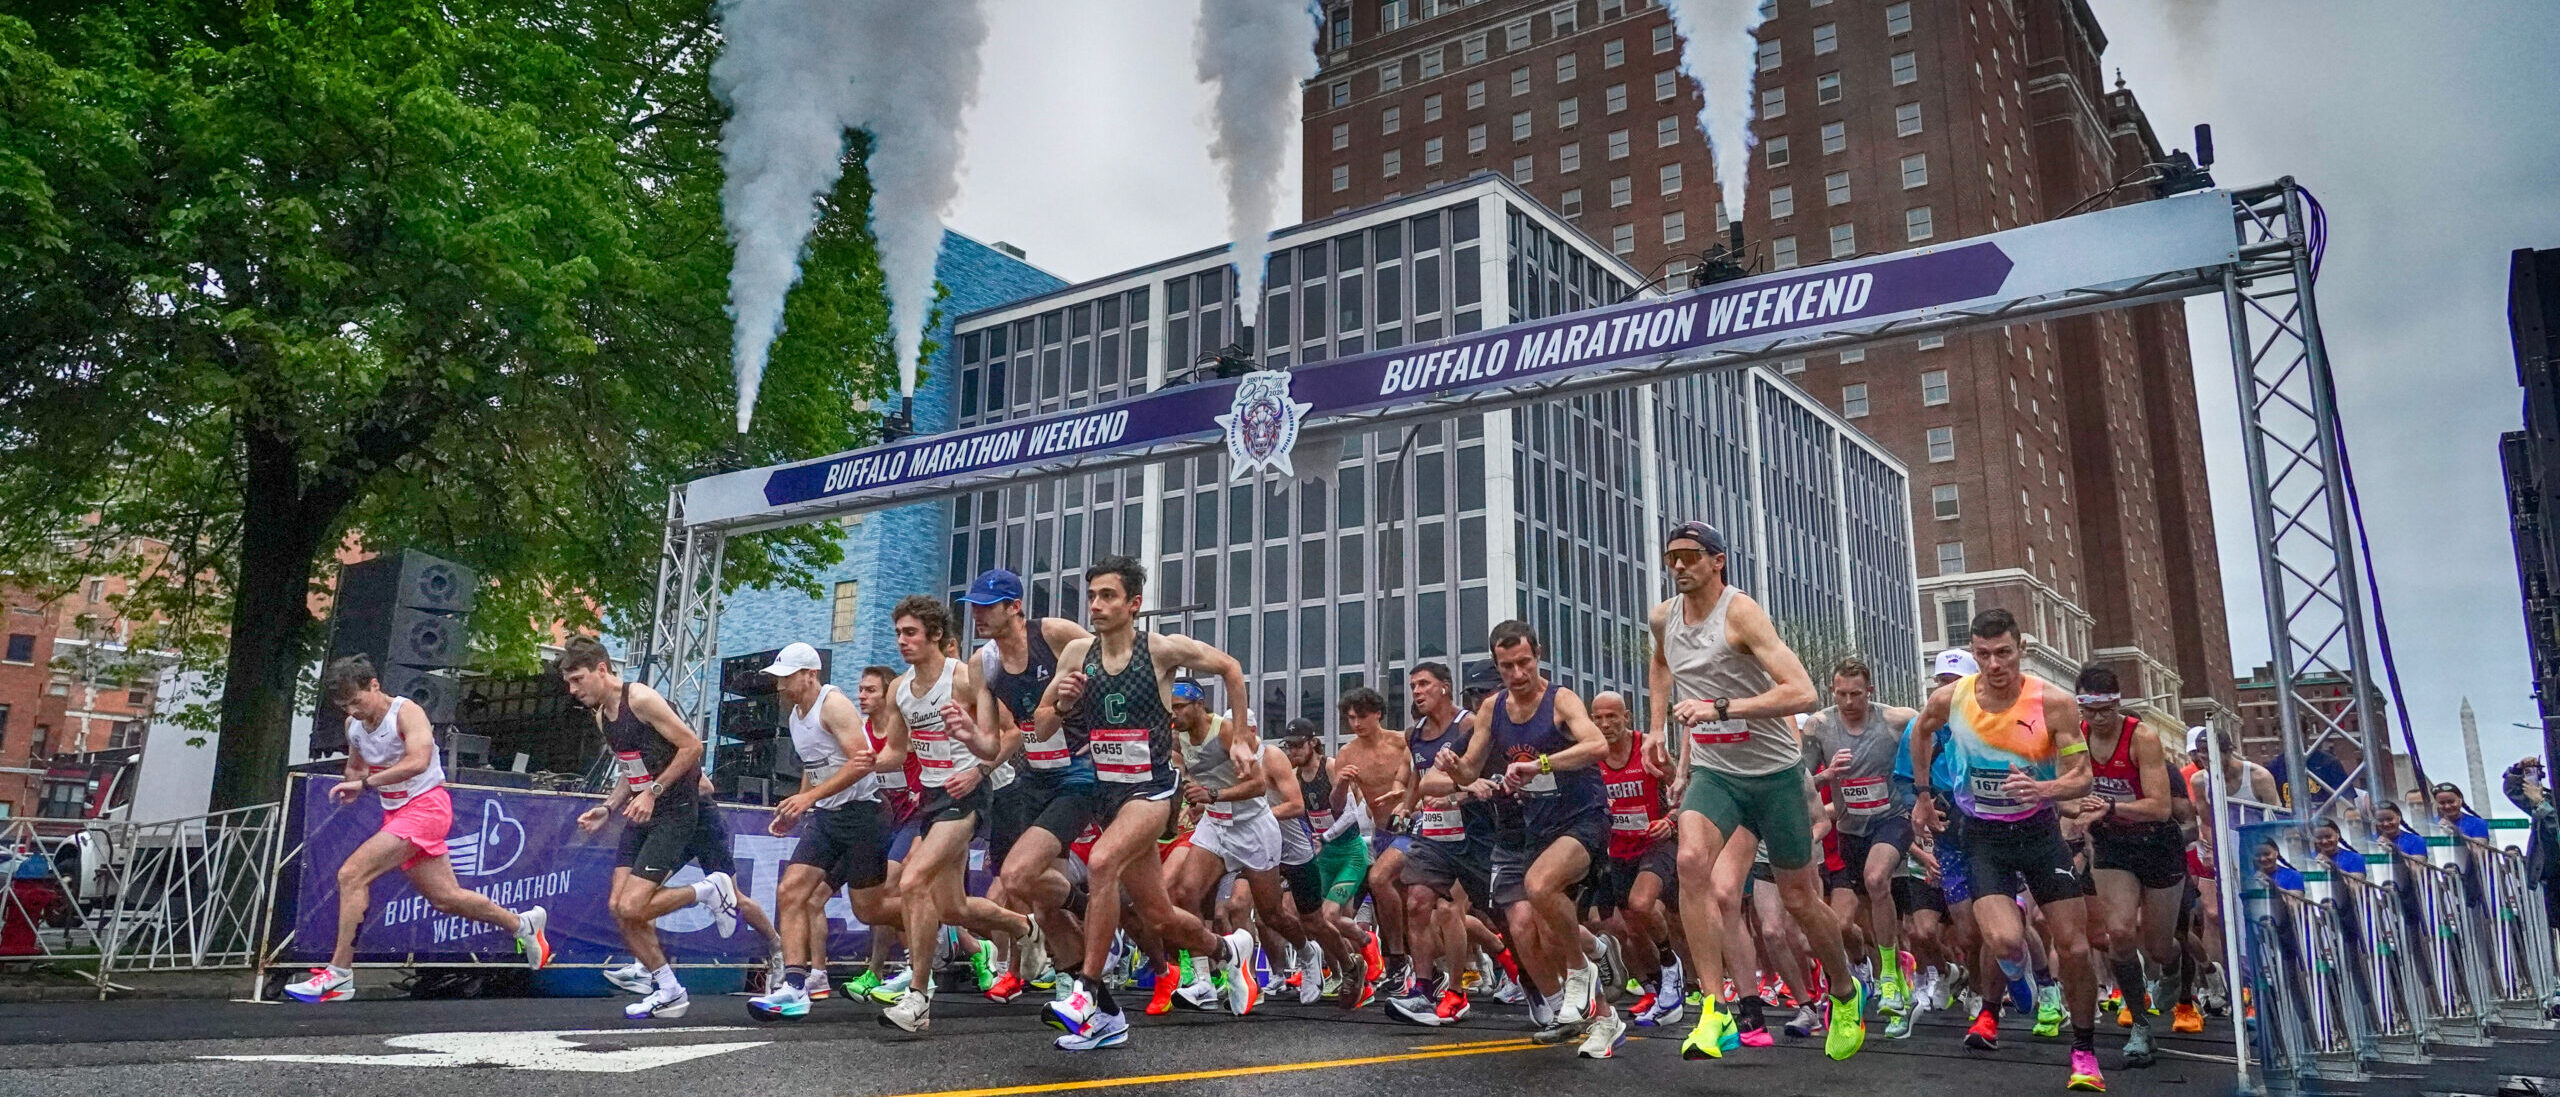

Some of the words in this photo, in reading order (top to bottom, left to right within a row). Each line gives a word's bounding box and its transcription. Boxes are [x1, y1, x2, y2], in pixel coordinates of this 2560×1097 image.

[1379, 338, 1511, 396] BUFFALO
[1514, 302, 1698, 372] MARATHON
[1706, 272, 1874, 337] WEEKEND
[823, 450, 907, 493] BUFFALO
[907, 428, 1025, 478] MARATHON
[1027, 408, 1130, 457] WEEKEND
[1104, 692, 1127, 725] C
[912, 740, 931, 752] 5527
[1092, 743, 1123, 755] 6455
[1605, 780, 1645, 799] EBERT
[1843, 786, 1868, 797] 6260
[1423, 813, 1443, 823] 3095
[1613, 815, 1630, 824] 594
[384, 894, 446, 927] BUFF
[474, 869, 572, 907] MARATHON
[432, 908, 518, 944] WEEK
